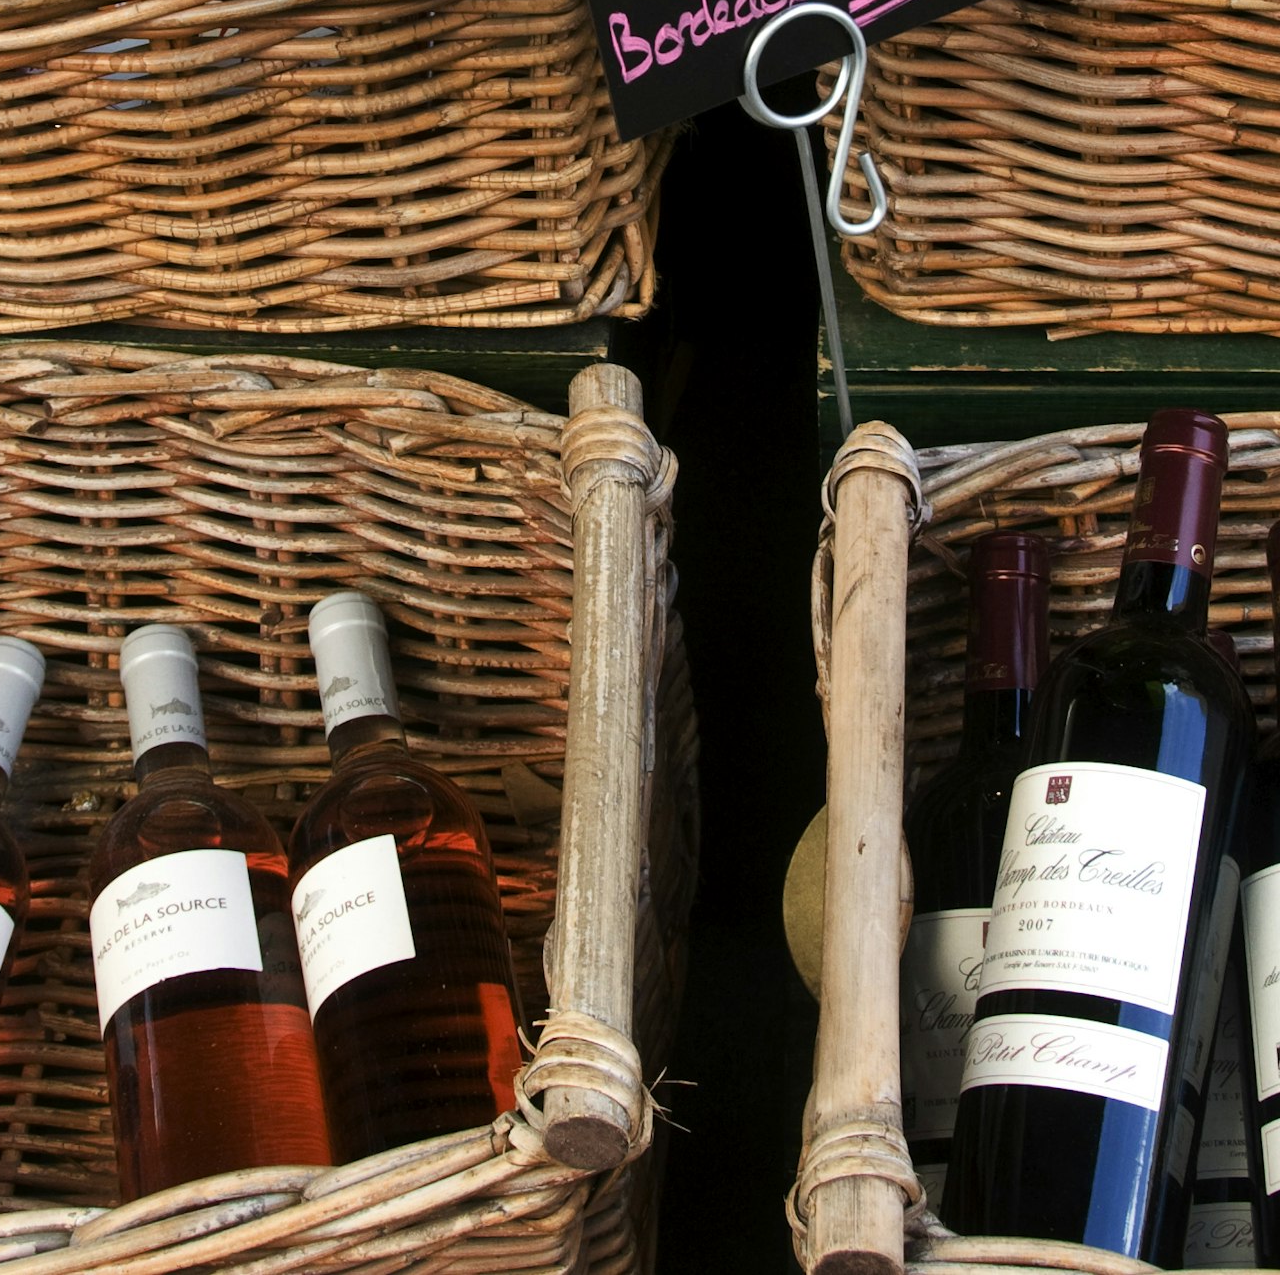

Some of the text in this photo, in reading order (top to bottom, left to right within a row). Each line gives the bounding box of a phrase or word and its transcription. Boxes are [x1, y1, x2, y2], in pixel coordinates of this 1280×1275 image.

[1024, 812, 1083, 847] Château
[1036, 853, 1070, 882] des
[1077, 848, 1166, 896] Treilles
[317, 889, 377, 932] SOURCE
[1017, 918, 1055, 932] 2007
[1042, 900, 1116, 915] BORDEAUX
[96, 897, 229, 966] MAS DE LA SOURCE
[1030, 1031, 1138, 1084] Champ
